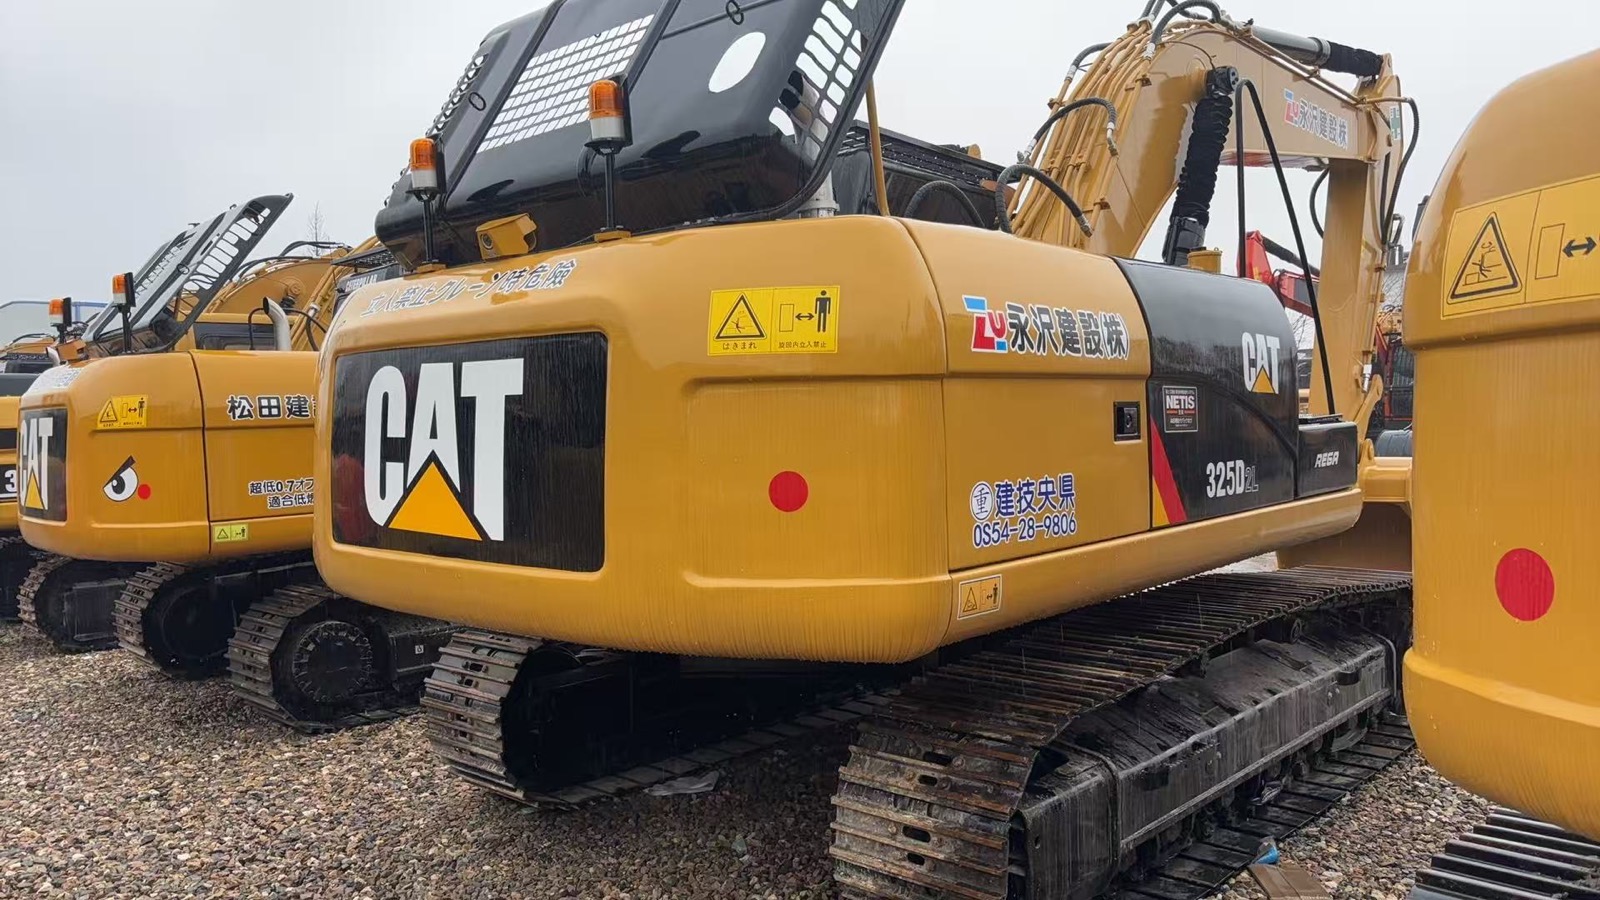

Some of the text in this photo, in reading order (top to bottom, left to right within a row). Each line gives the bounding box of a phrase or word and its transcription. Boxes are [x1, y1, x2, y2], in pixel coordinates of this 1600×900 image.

[1006, 302, 1130, 359] 永沢建設(株)
[1241, 332, 1280, 394] CAT
[1166, 395, 1195, 409] NETIS
[20, 417, 53, 510] CAT
[364, 358, 525, 541] CAT
